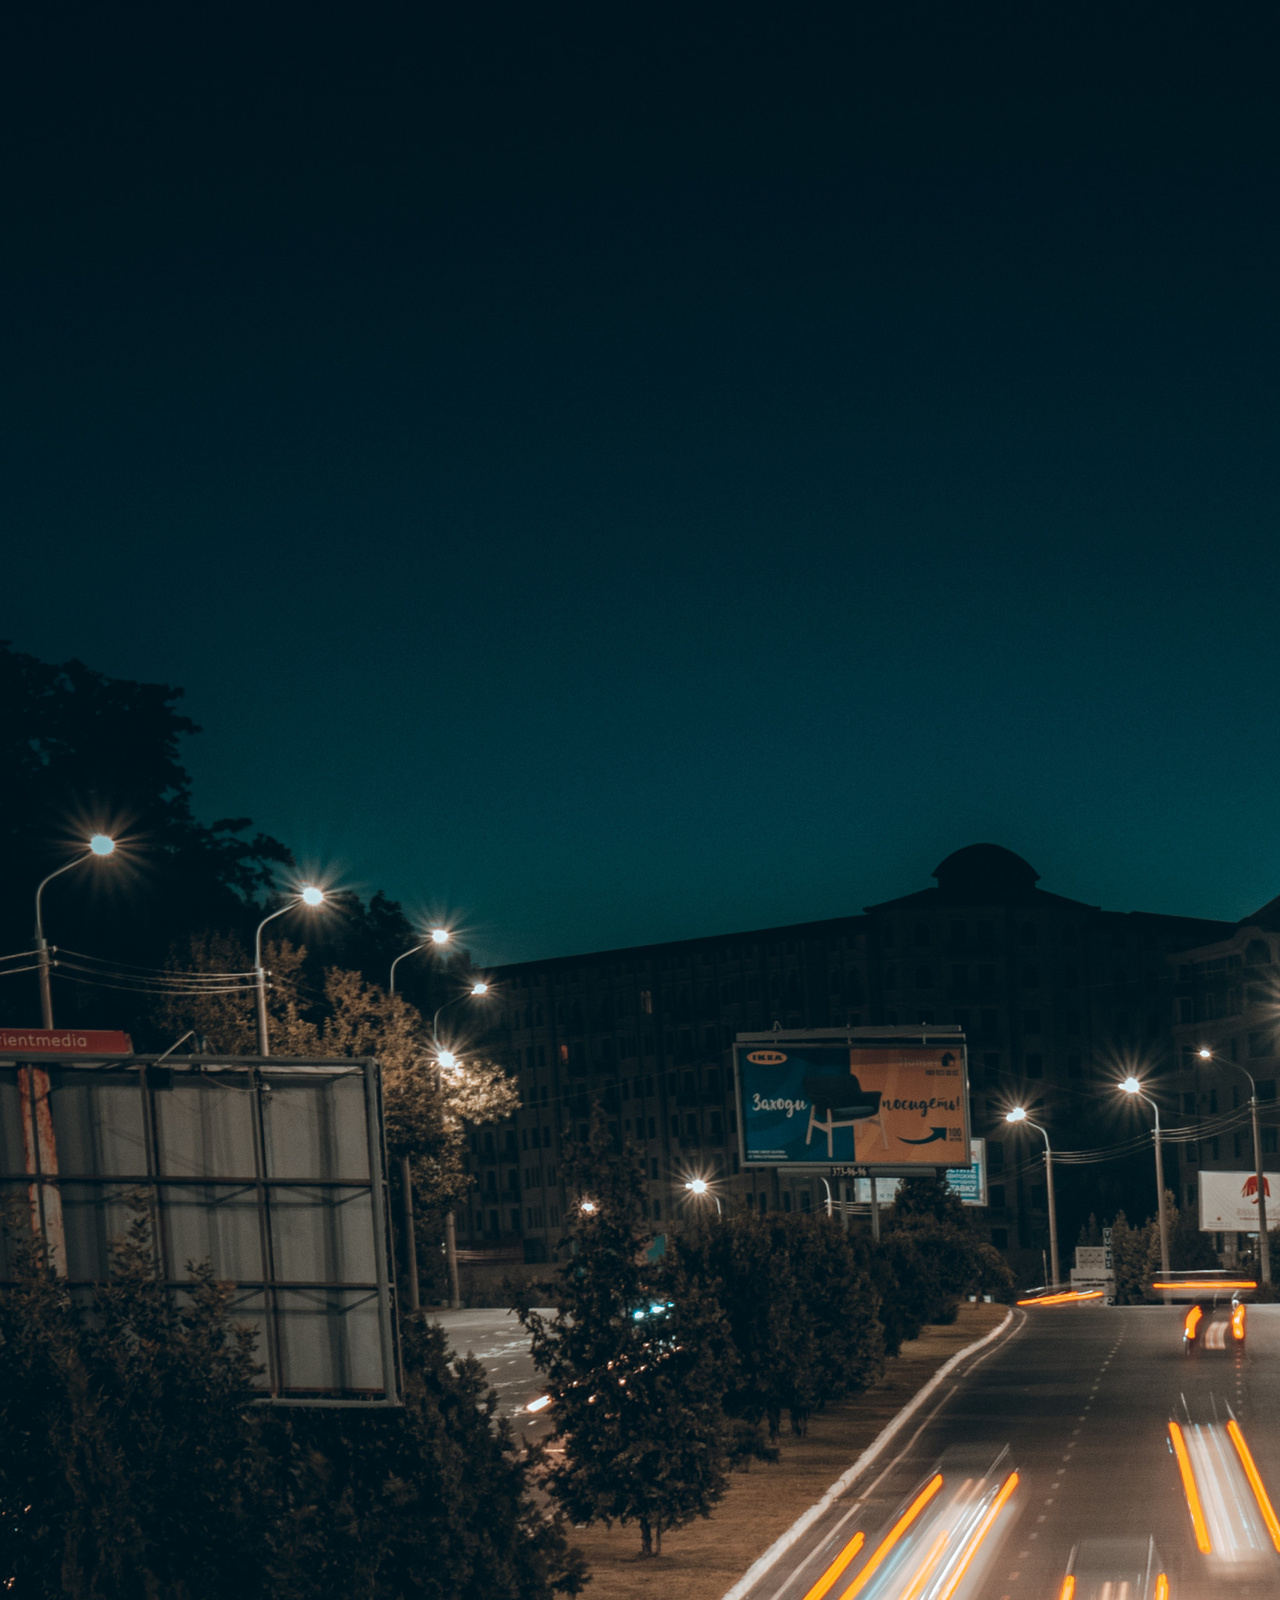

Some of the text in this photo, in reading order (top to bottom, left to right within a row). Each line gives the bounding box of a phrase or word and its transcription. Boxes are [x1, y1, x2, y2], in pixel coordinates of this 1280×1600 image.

[752, 1093, 960, 1118] Заходи посидеть!
[949, 1184, 977, 1193] ТАВКУ
